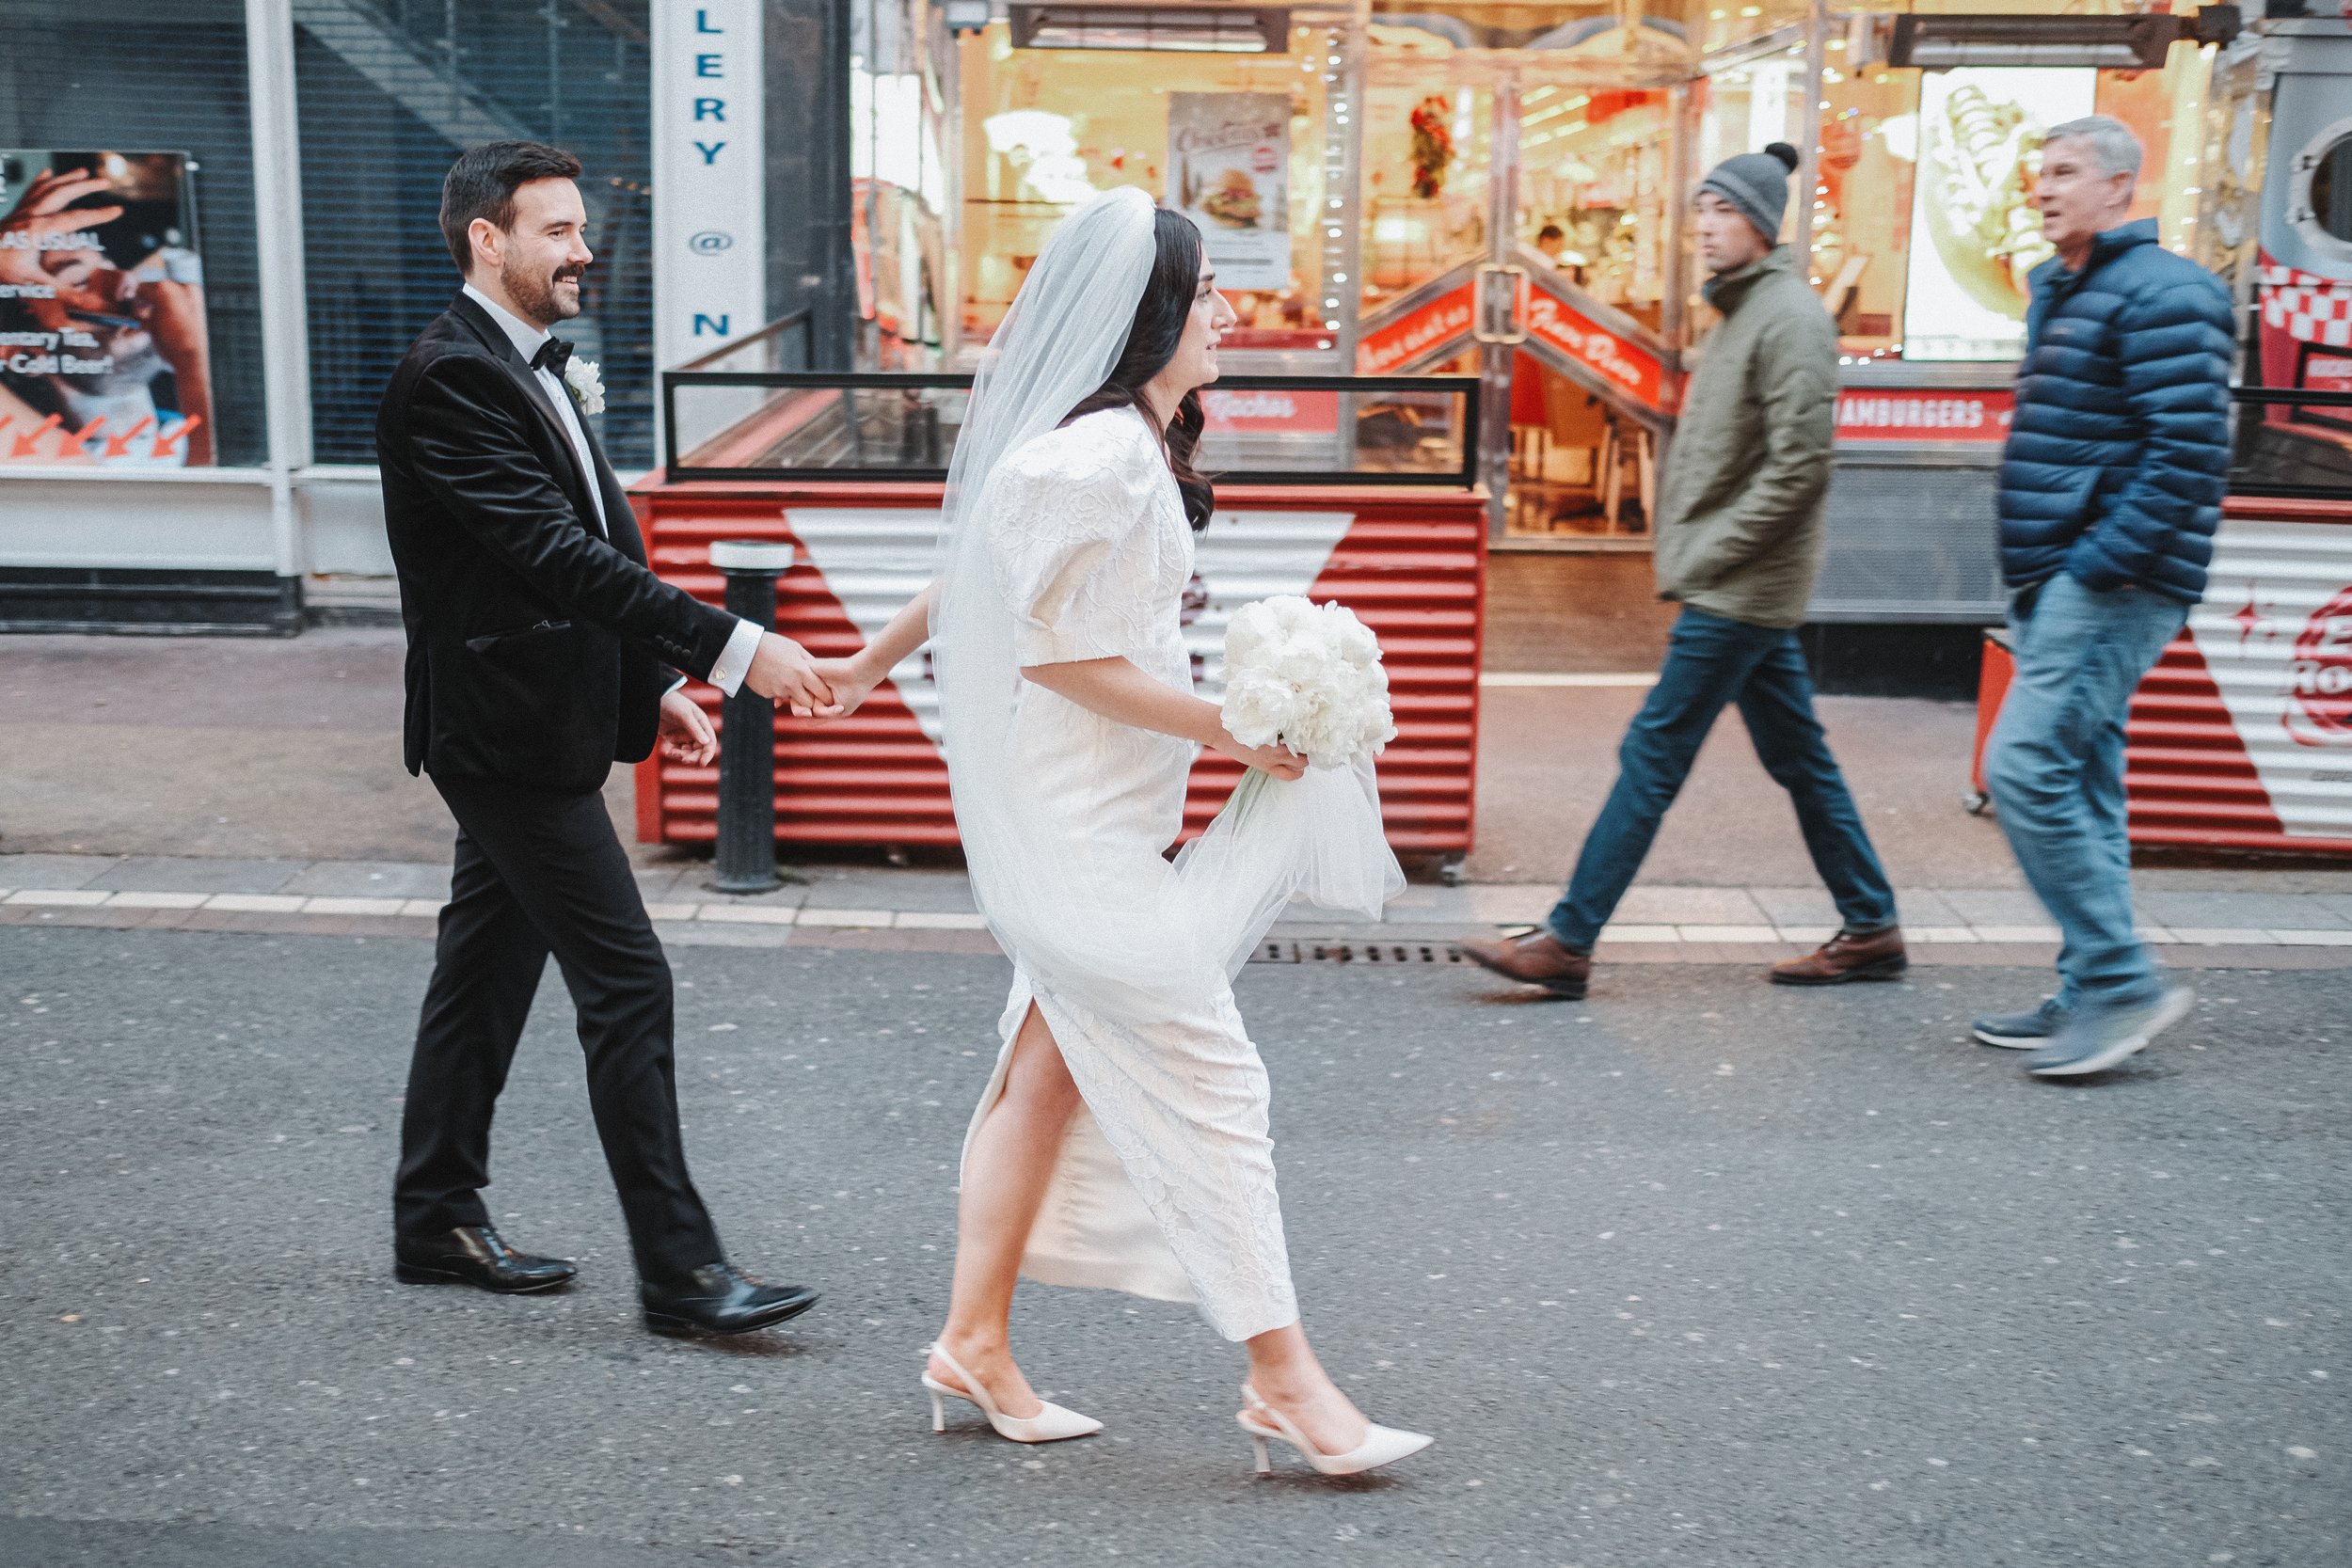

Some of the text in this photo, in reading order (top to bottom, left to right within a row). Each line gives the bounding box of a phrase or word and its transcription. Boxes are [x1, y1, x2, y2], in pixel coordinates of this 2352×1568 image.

[33, 230, 106, 251] USUAL
[689, 8, 733, 337] LERY @ N
